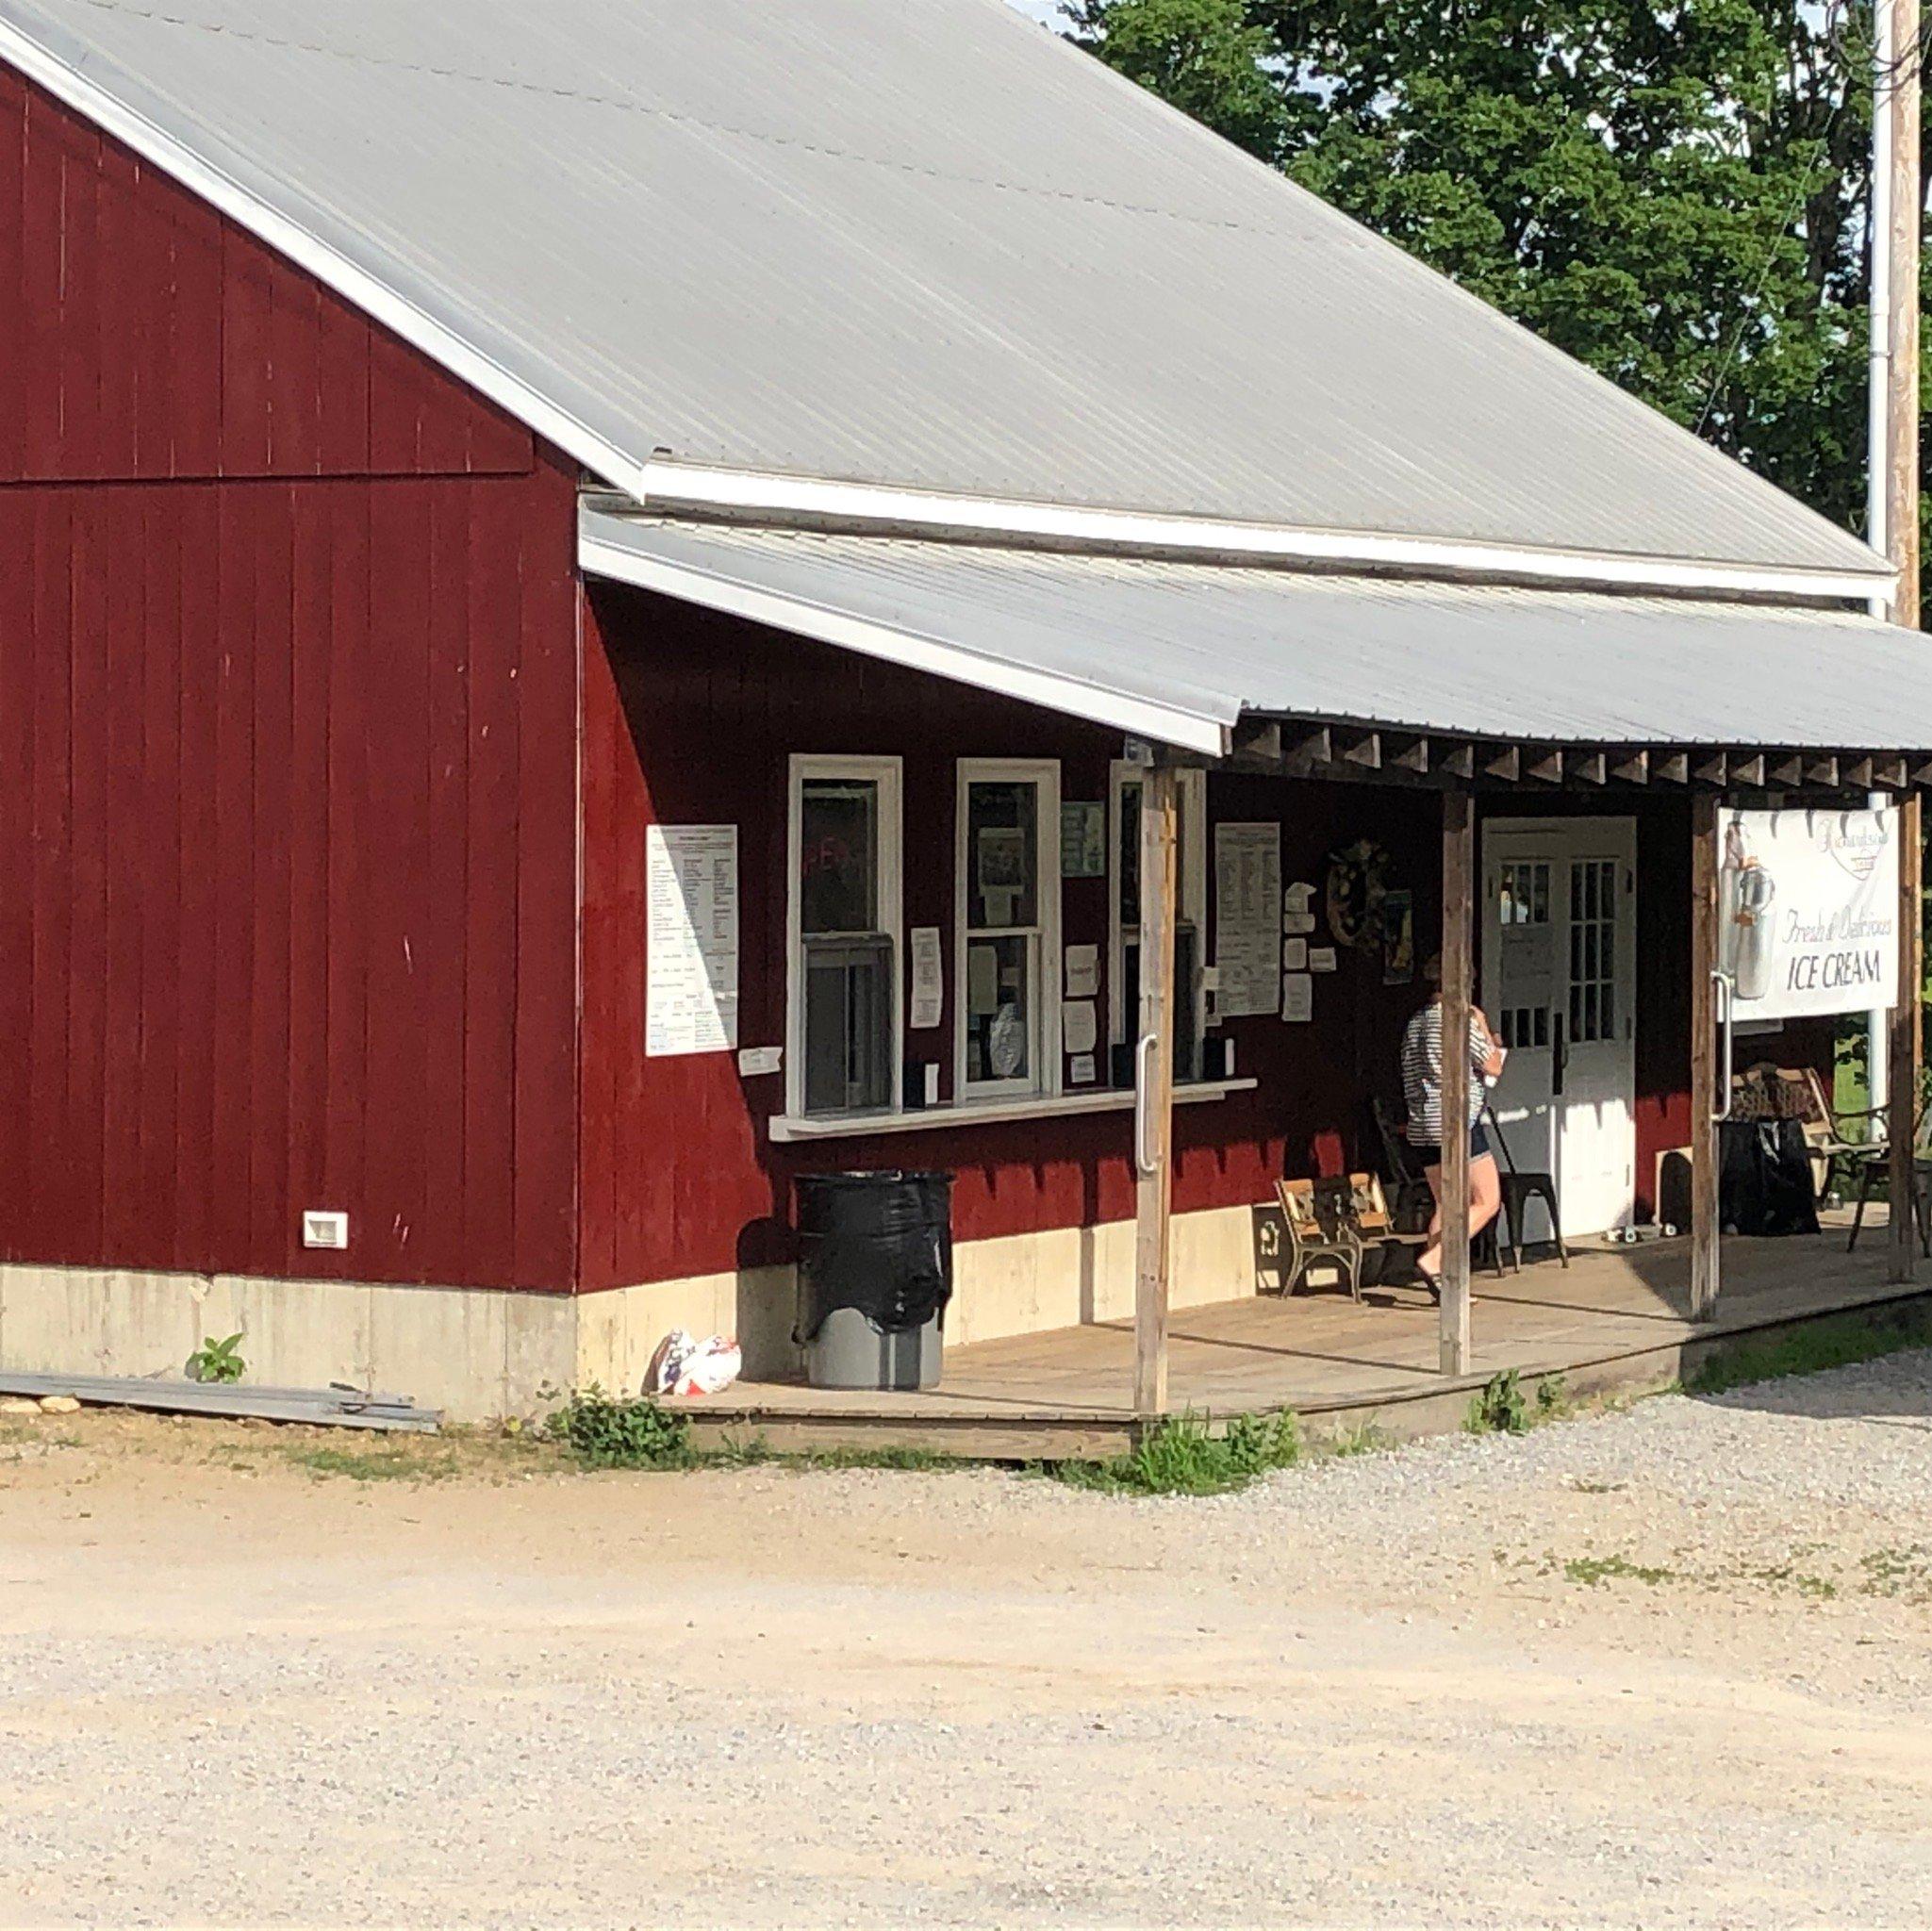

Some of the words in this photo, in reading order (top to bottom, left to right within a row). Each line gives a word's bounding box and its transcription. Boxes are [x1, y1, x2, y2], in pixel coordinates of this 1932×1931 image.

[1782, 908, 1825, 944] Fresh
[1787, 955, 1820, 991] ICE
[1822, 950, 1882, 989] CREAM
